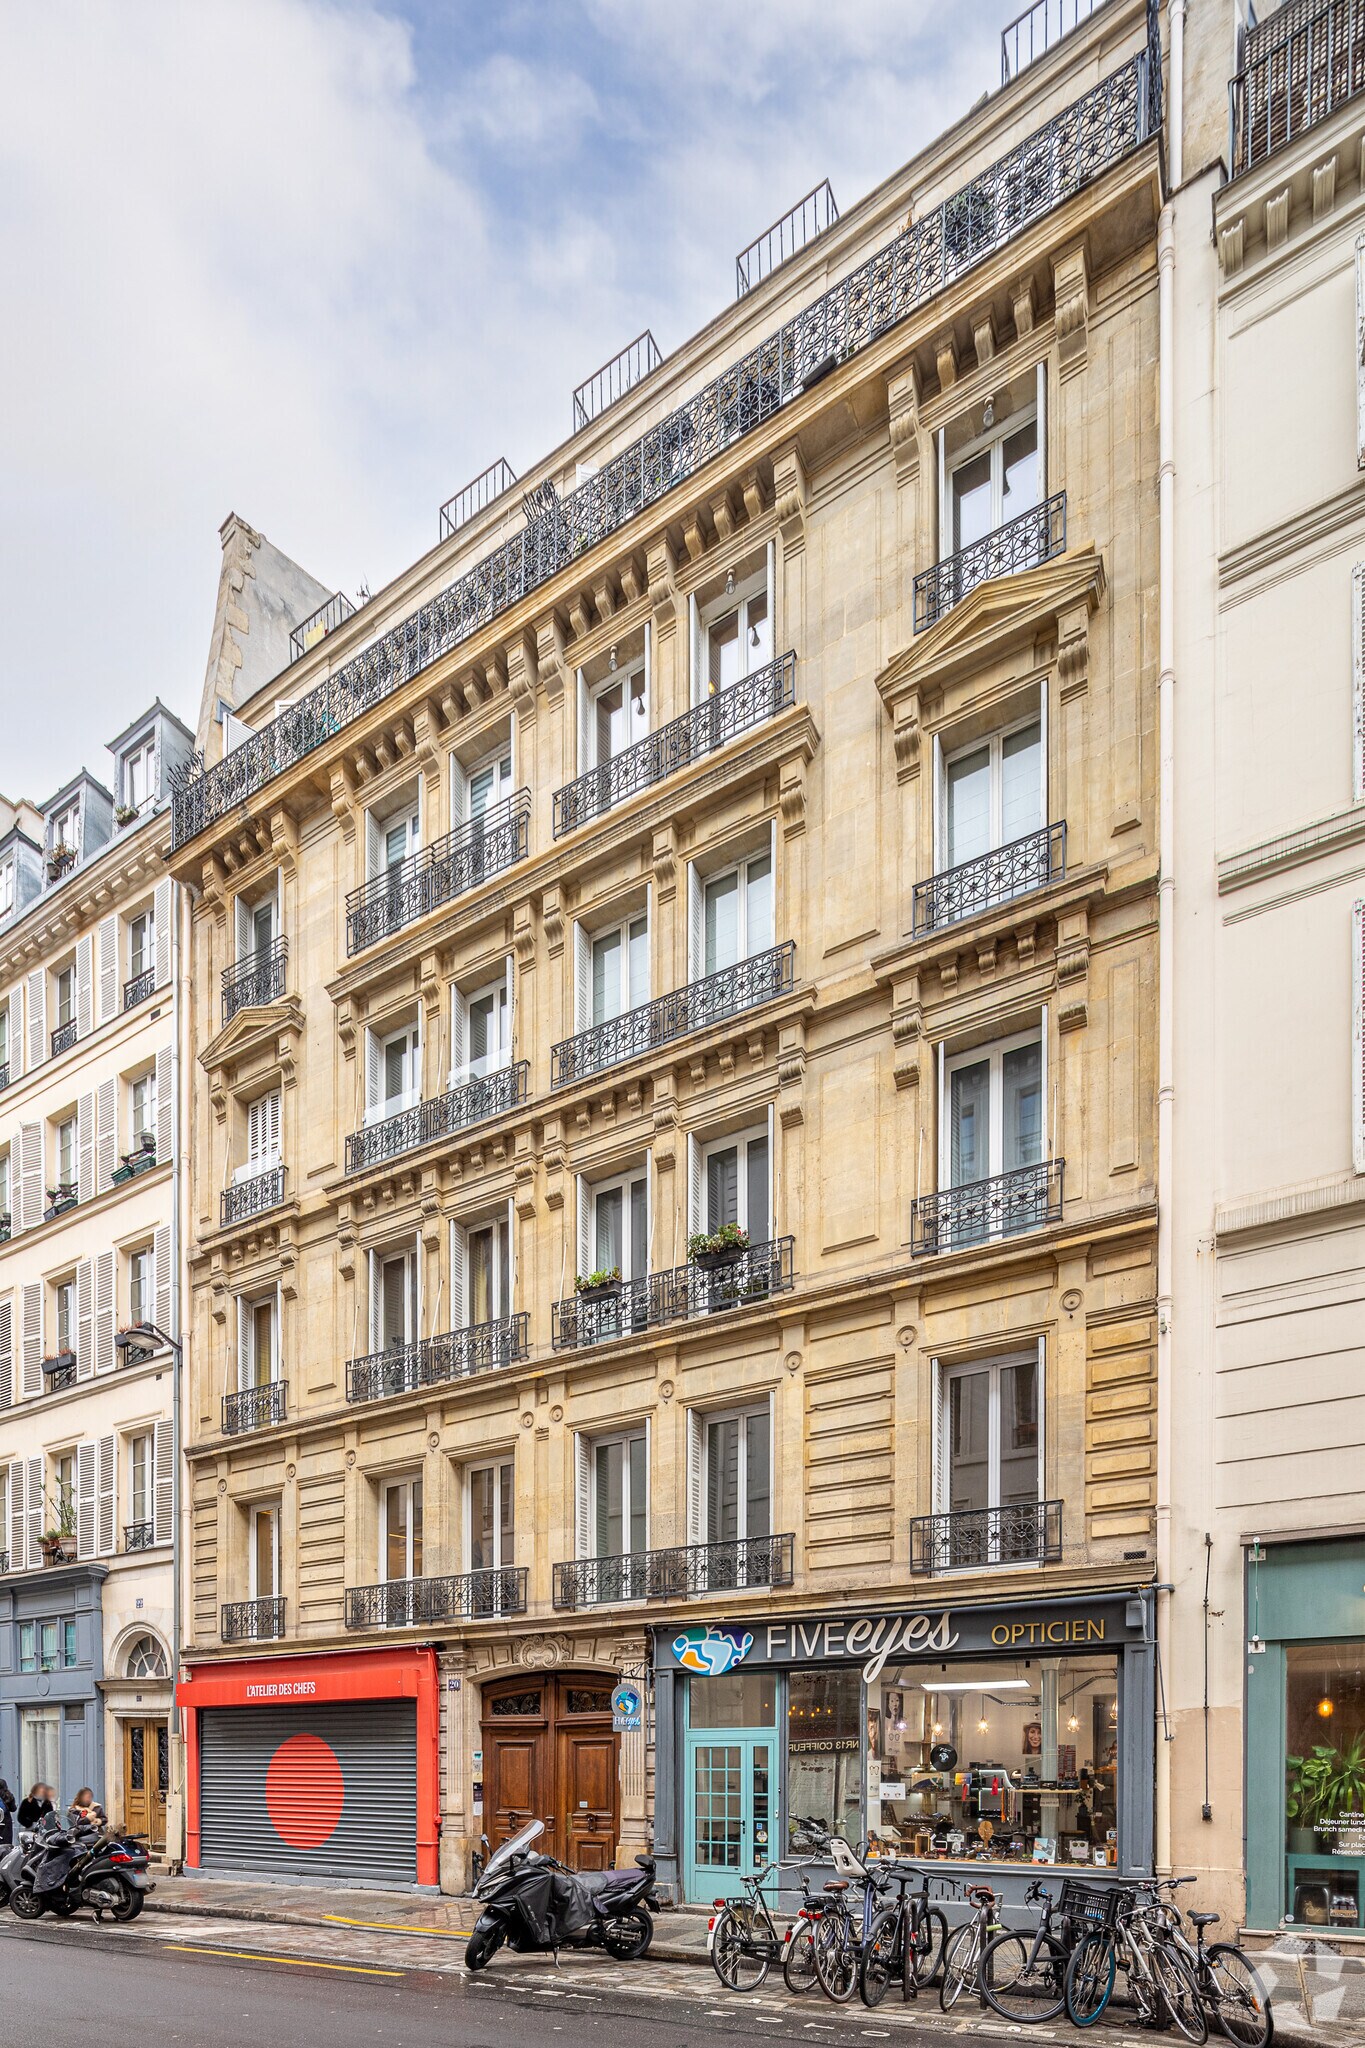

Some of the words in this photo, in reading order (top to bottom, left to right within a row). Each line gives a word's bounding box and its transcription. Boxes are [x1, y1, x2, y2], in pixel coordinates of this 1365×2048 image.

[991, 1619, 1105, 1646] OPTICIEN
[279, 1683, 292, 1696] DES
[293, 1681, 316, 1694] CHEFS
[449, 1680, 459, 1689] 20
